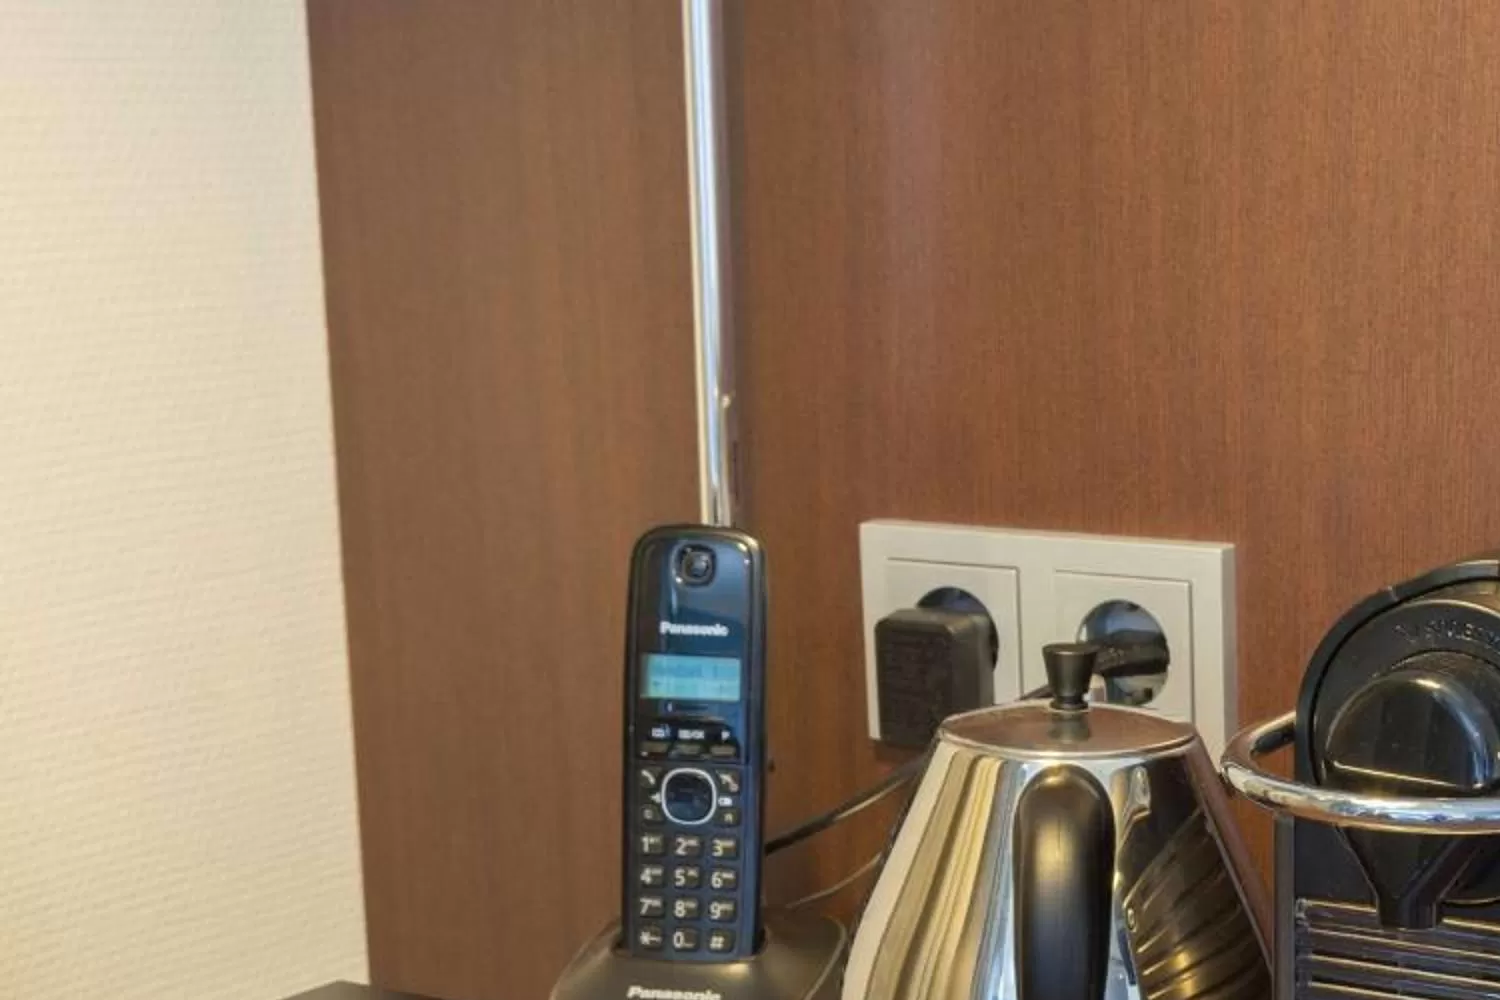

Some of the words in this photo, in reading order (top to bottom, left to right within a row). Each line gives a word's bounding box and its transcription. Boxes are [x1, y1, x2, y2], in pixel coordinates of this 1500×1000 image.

[660, 621, 729, 636] Panasonic
[675, 838, 686, 855] 2
[712, 839, 723, 856] 3
[640, 868, 652, 884] 4
[675, 868, 686, 886] 5
[712, 871, 723, 888] 6
[640, 898, 651, 915] 7
[675, 900, 686, 917] 8
[710, 902, 721, 919] 9
